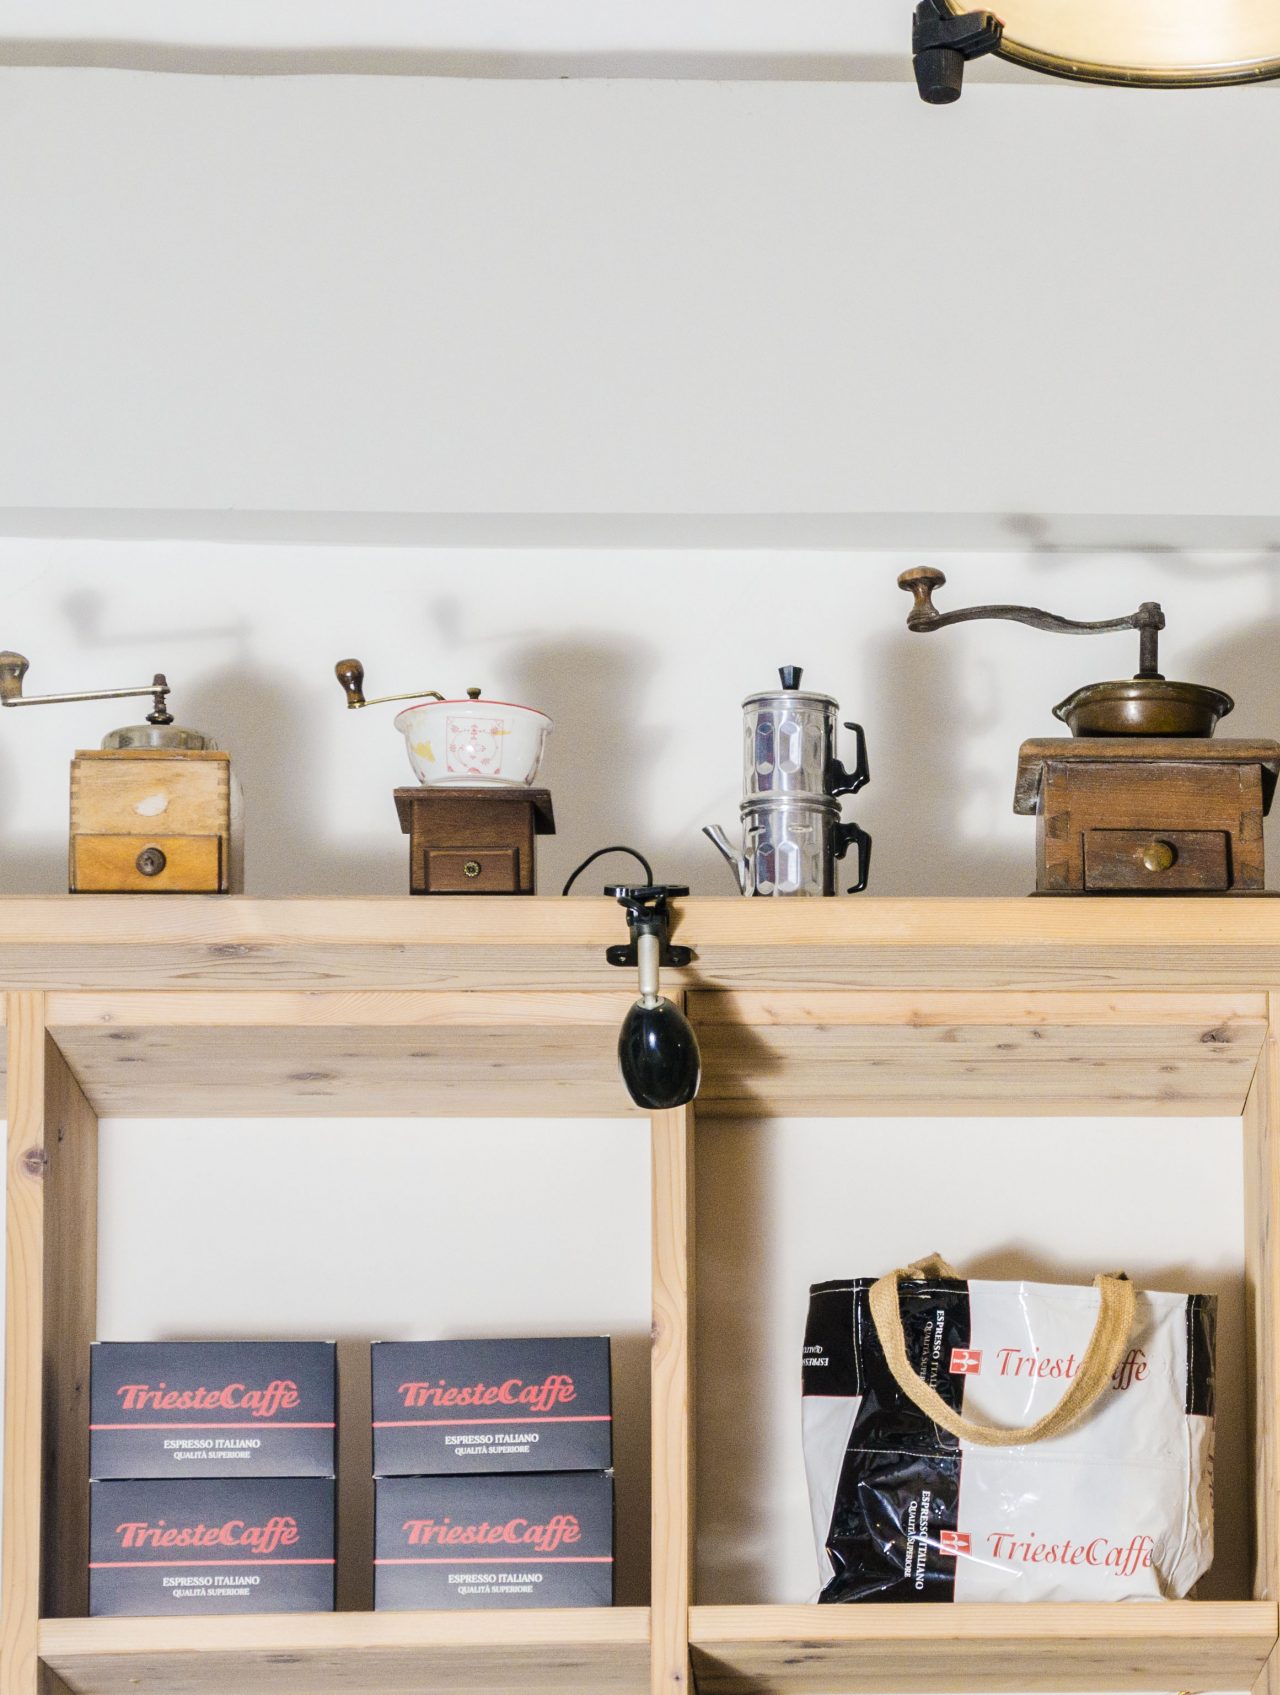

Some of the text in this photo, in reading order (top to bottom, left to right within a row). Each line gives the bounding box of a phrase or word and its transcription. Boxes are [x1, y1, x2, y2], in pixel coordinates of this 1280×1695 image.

[919, 1321, 934, 1381] QUALITÀ SUPER
[929, 1310, 945, 1392] ESPRESSO ITALI
[996, 1346, 1148, 1391] Triestffè
[117, 1379, 300, 1417] TriesteCaffè
[398, 1374, 577, 1412] TriesteCaffè
[163, 1439, 261, 1449] ESPRESSO ITALIANO
[173, 1450, 251, 1460] QUALITÀ SUPERIORE
[445, 1433, 539, 1445] ESPRESSO ITALIANO
[454, 1445, 530, 1456] QUALITÀ SUPERIORE
[115, 1516, 300, 1553] TriesteCaffè
[403, 1514, 582, 1552] TriesteCaffè
[915, 1490, 931, 1590] ESPRESSO ITALIANO
[904, 1536, 916, 1578] SUPERIORE
[163, 1576, 260, 1587] ESPRESSO ITALIANO
[172, 1587, 250, 1598] QUALITÀ SUPERIORE
[448, 1573, 543, 1584] ESPRESSO ITALIANO
[457, 1585, 533, 1595] QUALITÀ SUPERIORE
